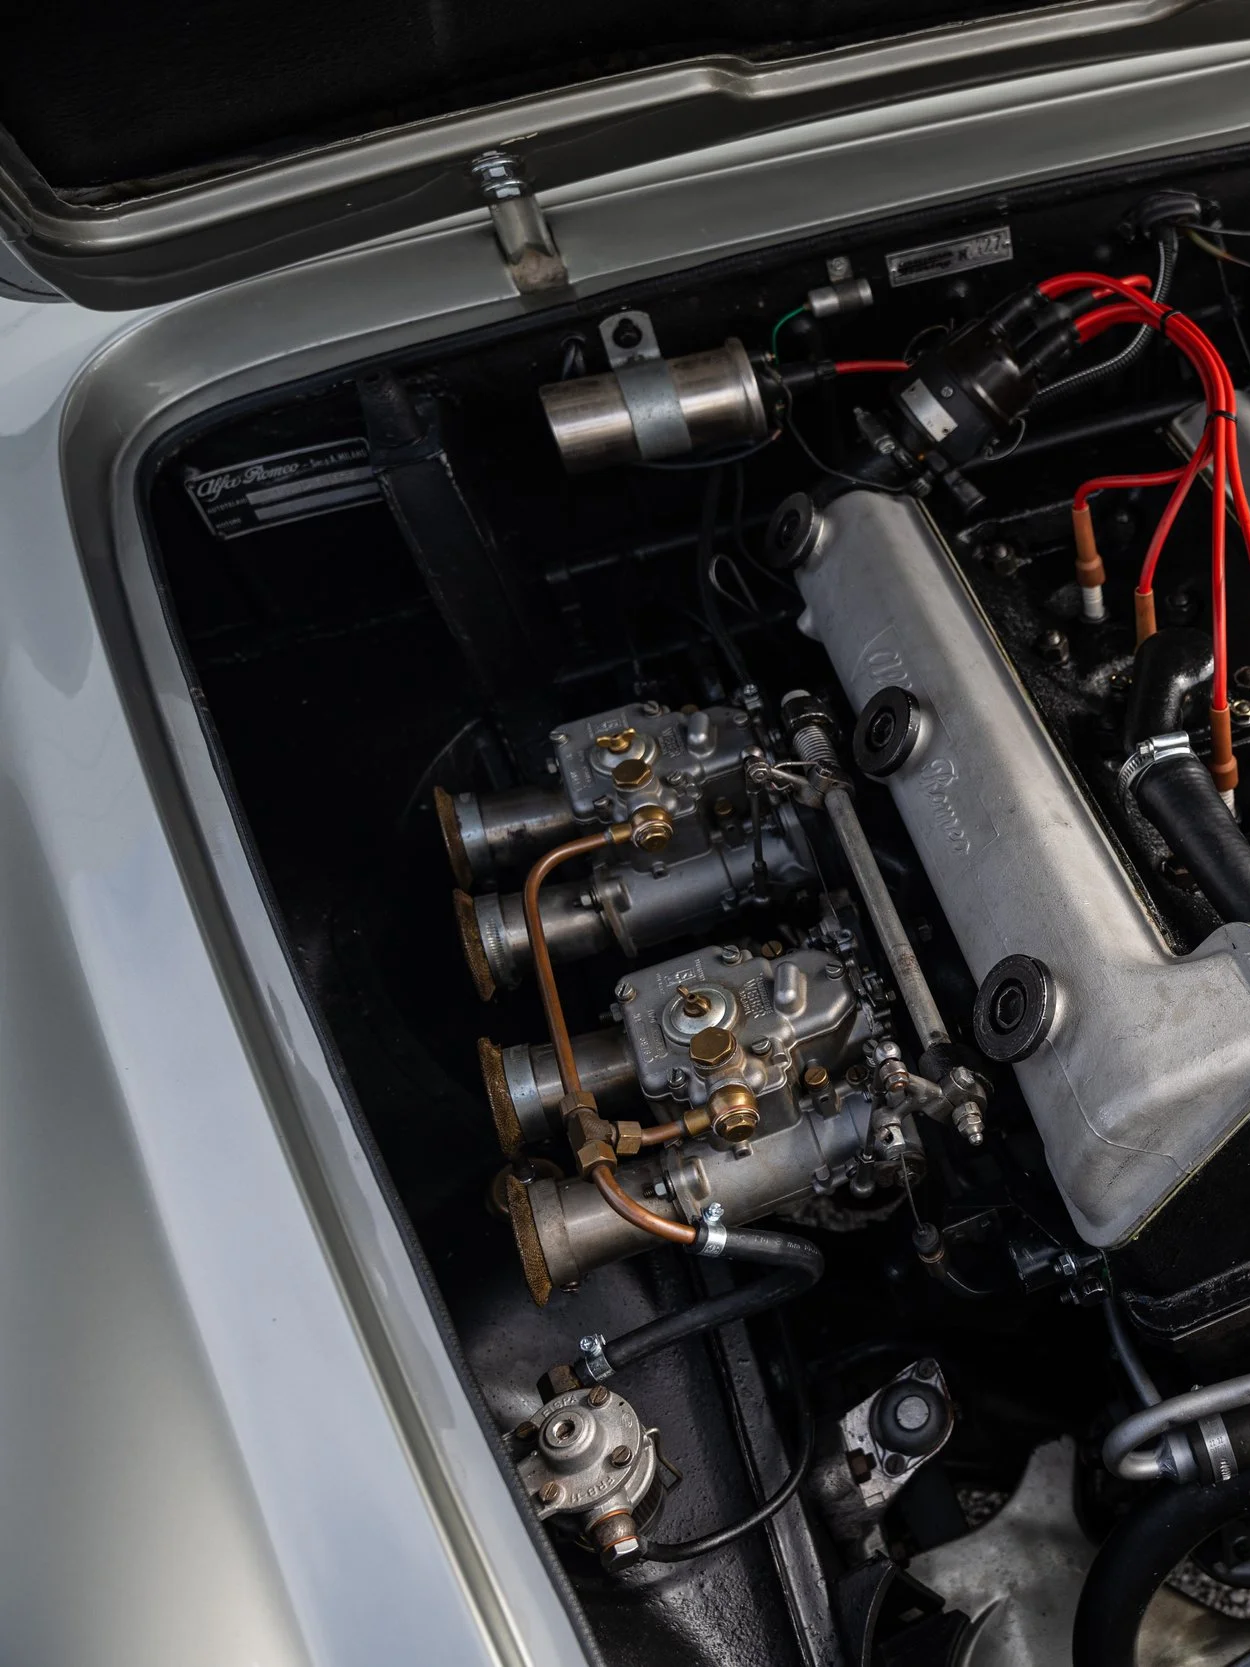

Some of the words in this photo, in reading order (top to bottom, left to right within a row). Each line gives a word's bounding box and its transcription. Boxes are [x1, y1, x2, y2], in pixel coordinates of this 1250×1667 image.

[196, 474, 242, 502] Alfa
[242, 464, 299, 486] Romeo
[745, 978, 767, 1019] WEBER
